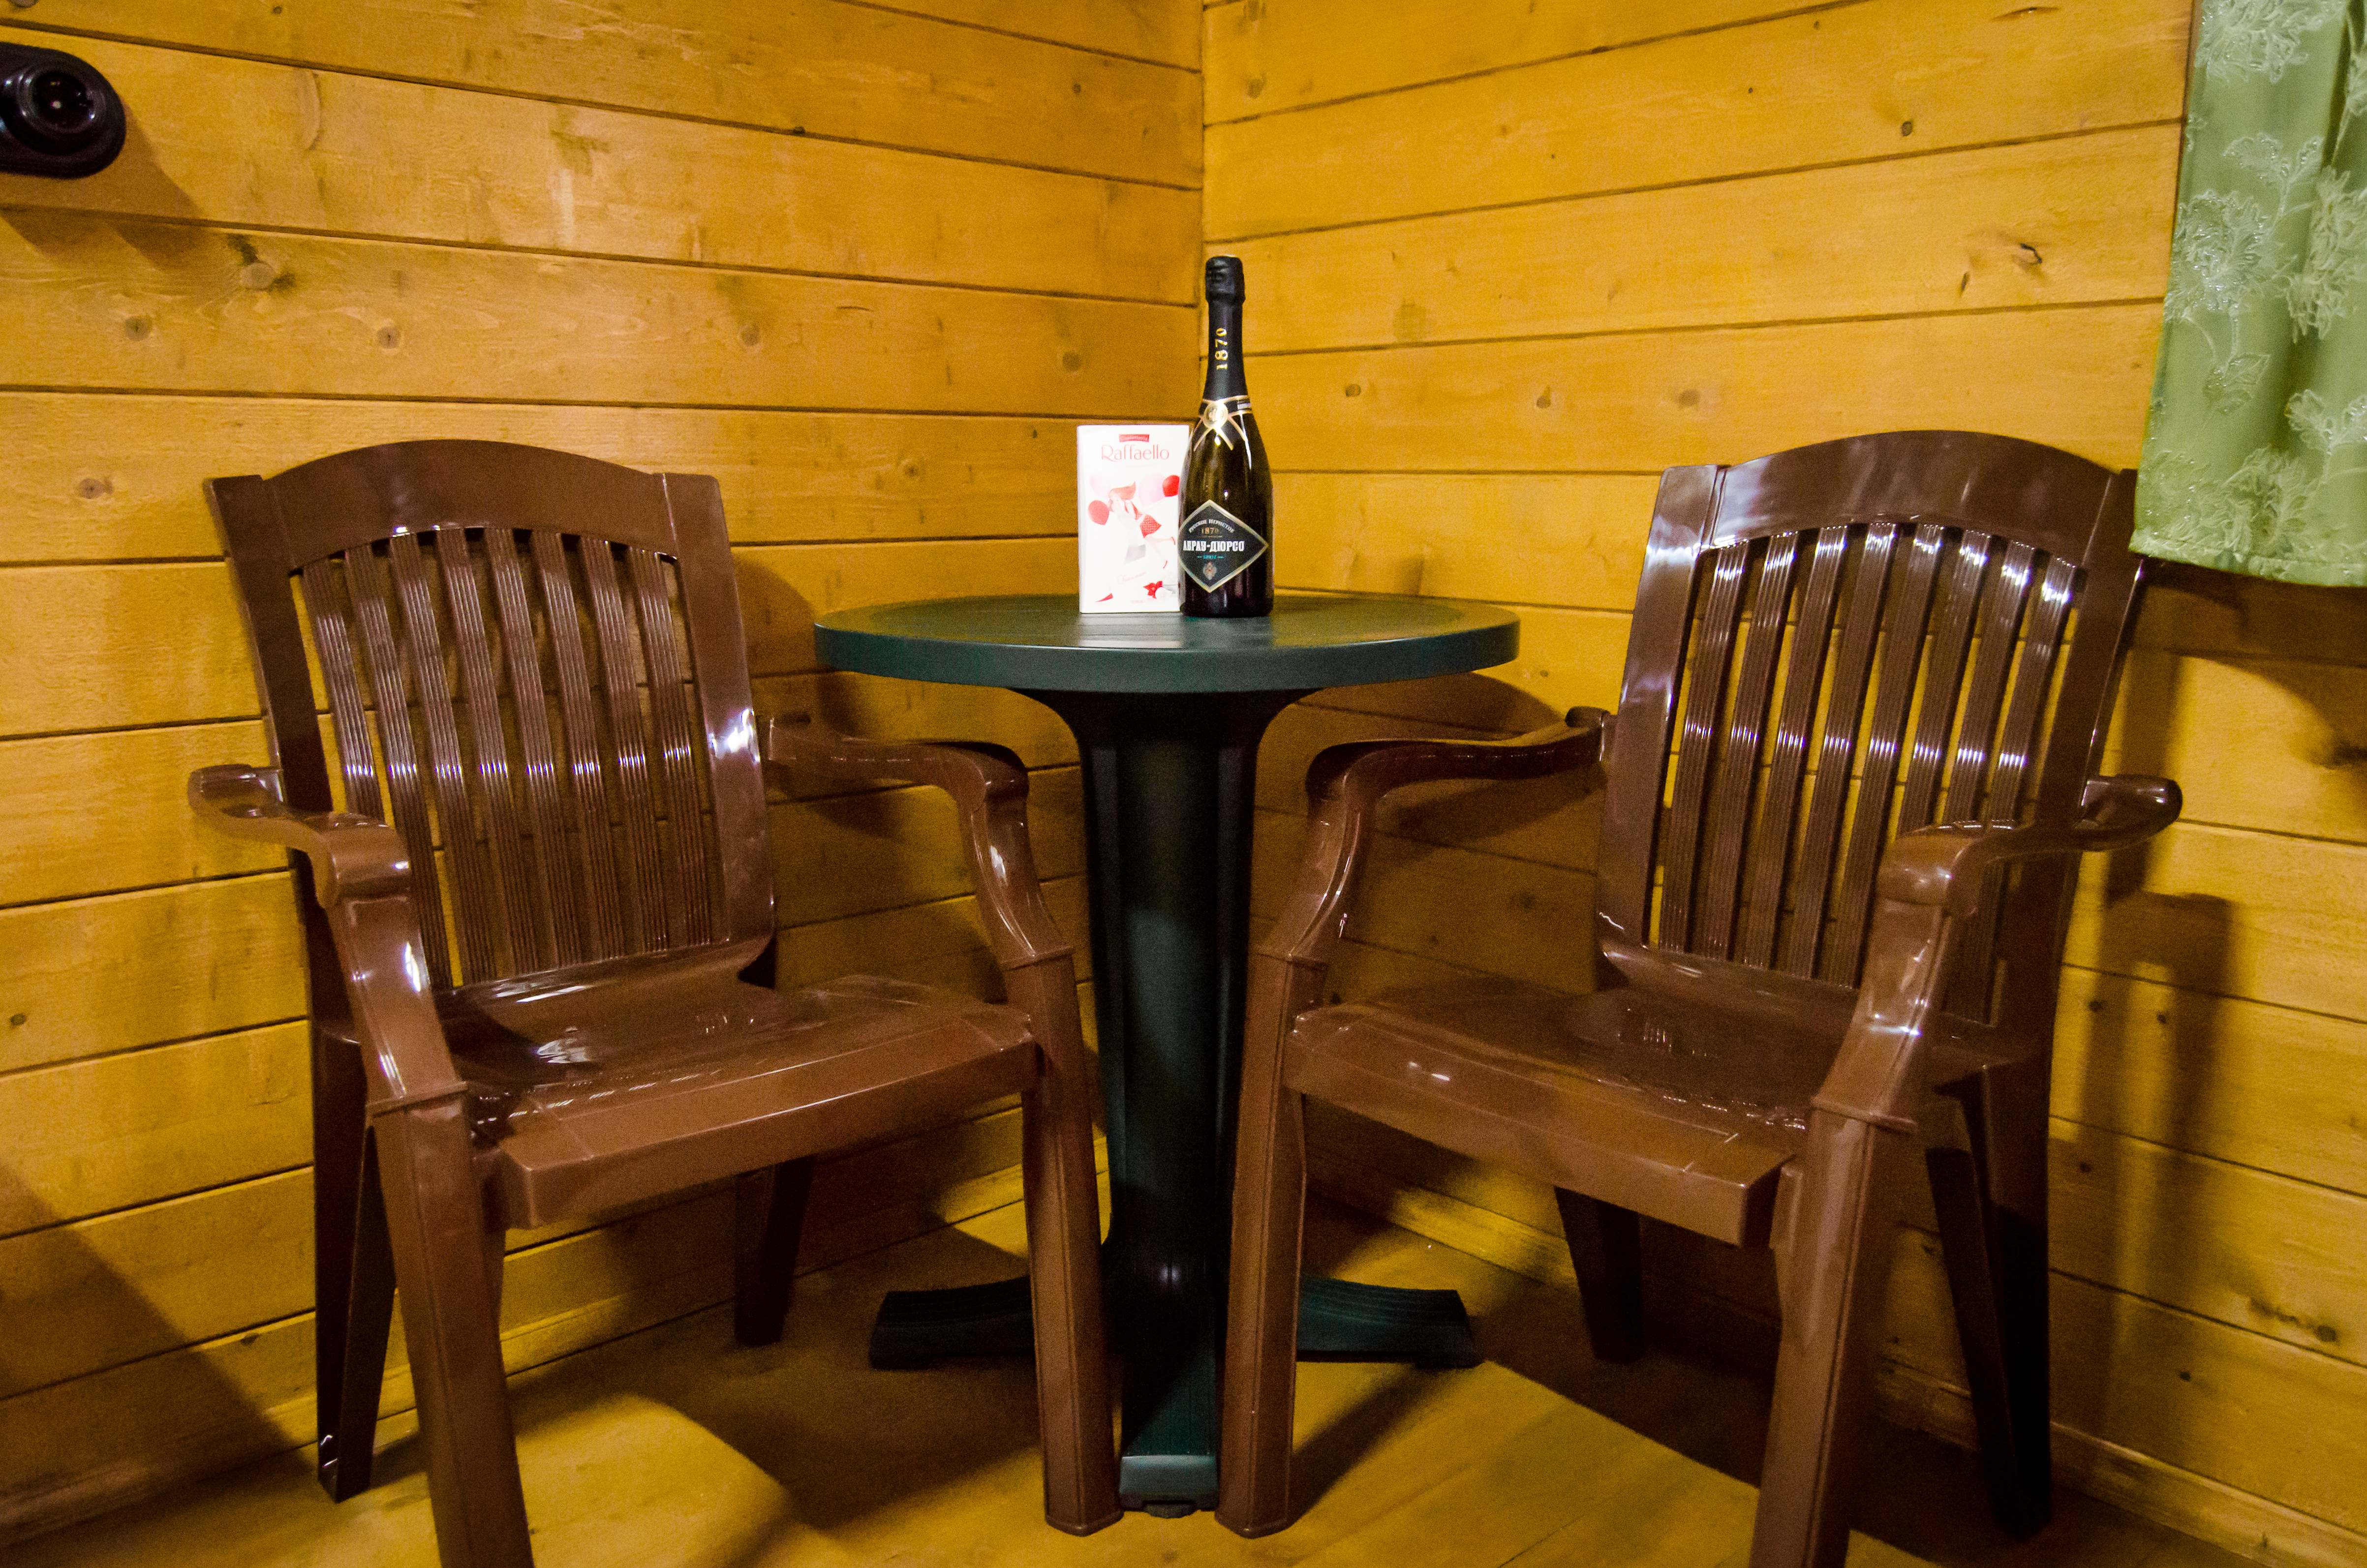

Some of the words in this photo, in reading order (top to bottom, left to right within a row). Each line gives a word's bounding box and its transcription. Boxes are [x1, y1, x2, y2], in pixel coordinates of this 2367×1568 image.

[1214, 327, 1229, 370] 1870
[1101, 444, 1169, 462] Raffaello
[1183, 540, 1245, 553] АБРАУ-ДЮРСО
